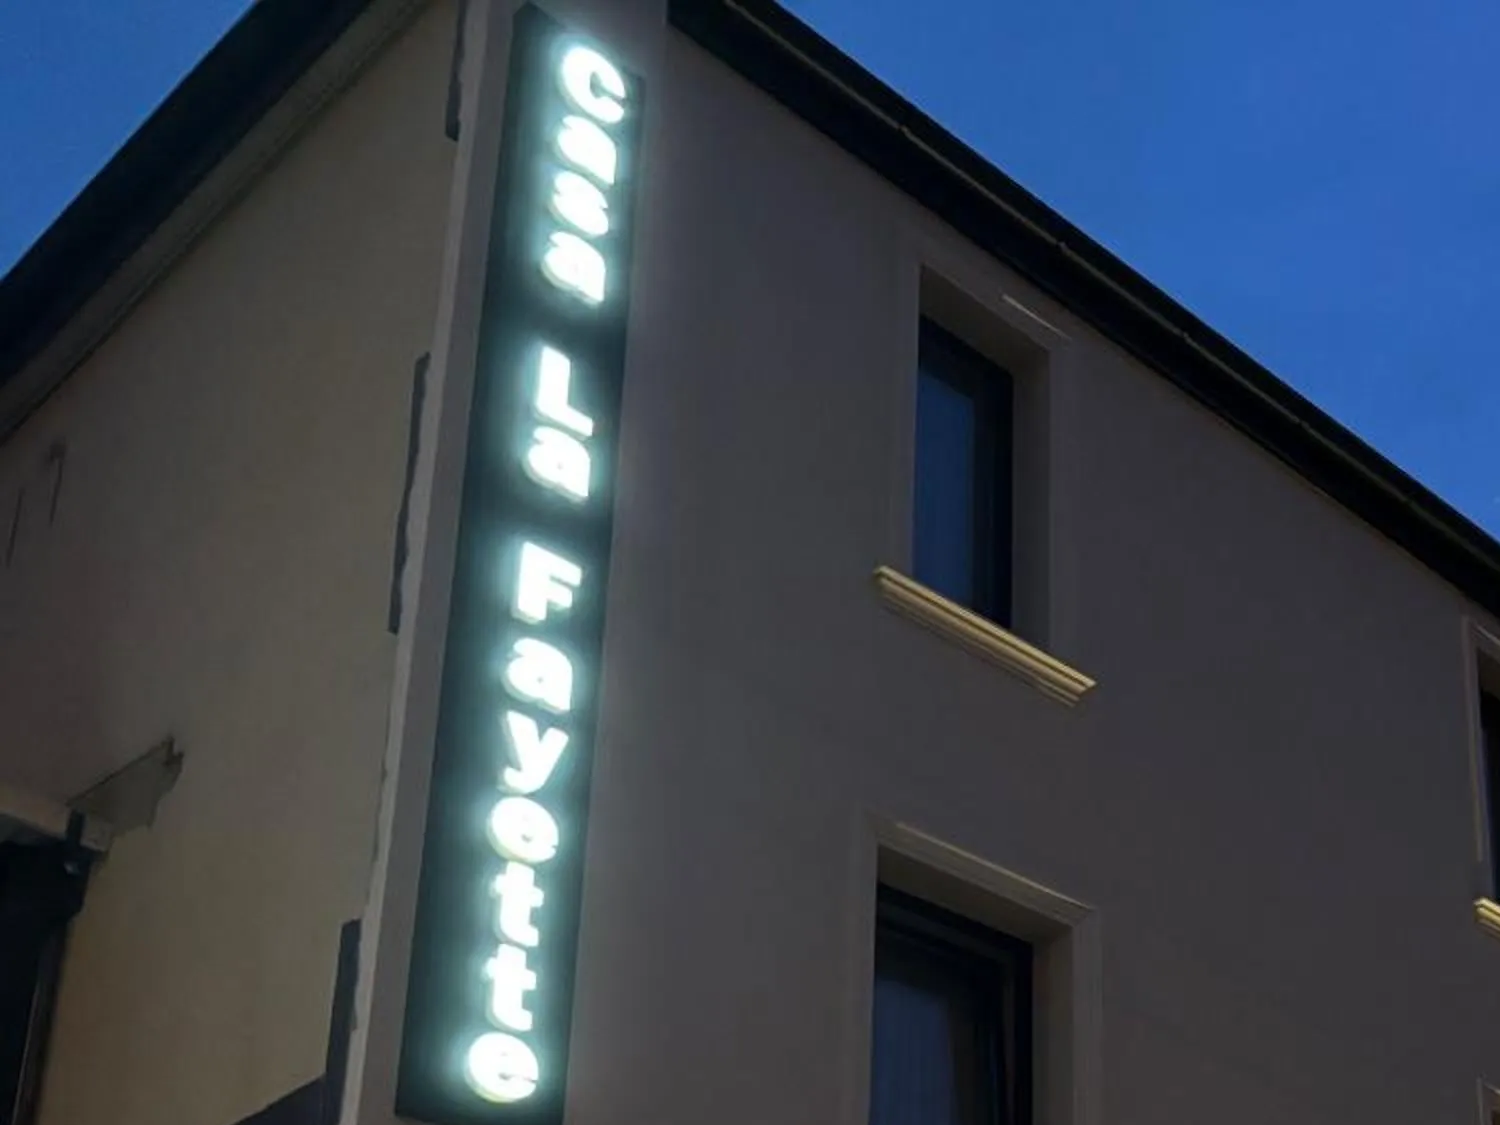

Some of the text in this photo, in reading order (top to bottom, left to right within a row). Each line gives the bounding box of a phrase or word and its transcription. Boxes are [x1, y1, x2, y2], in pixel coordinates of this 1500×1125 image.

[467, 44, 627, 1104] Casa La Fayette
